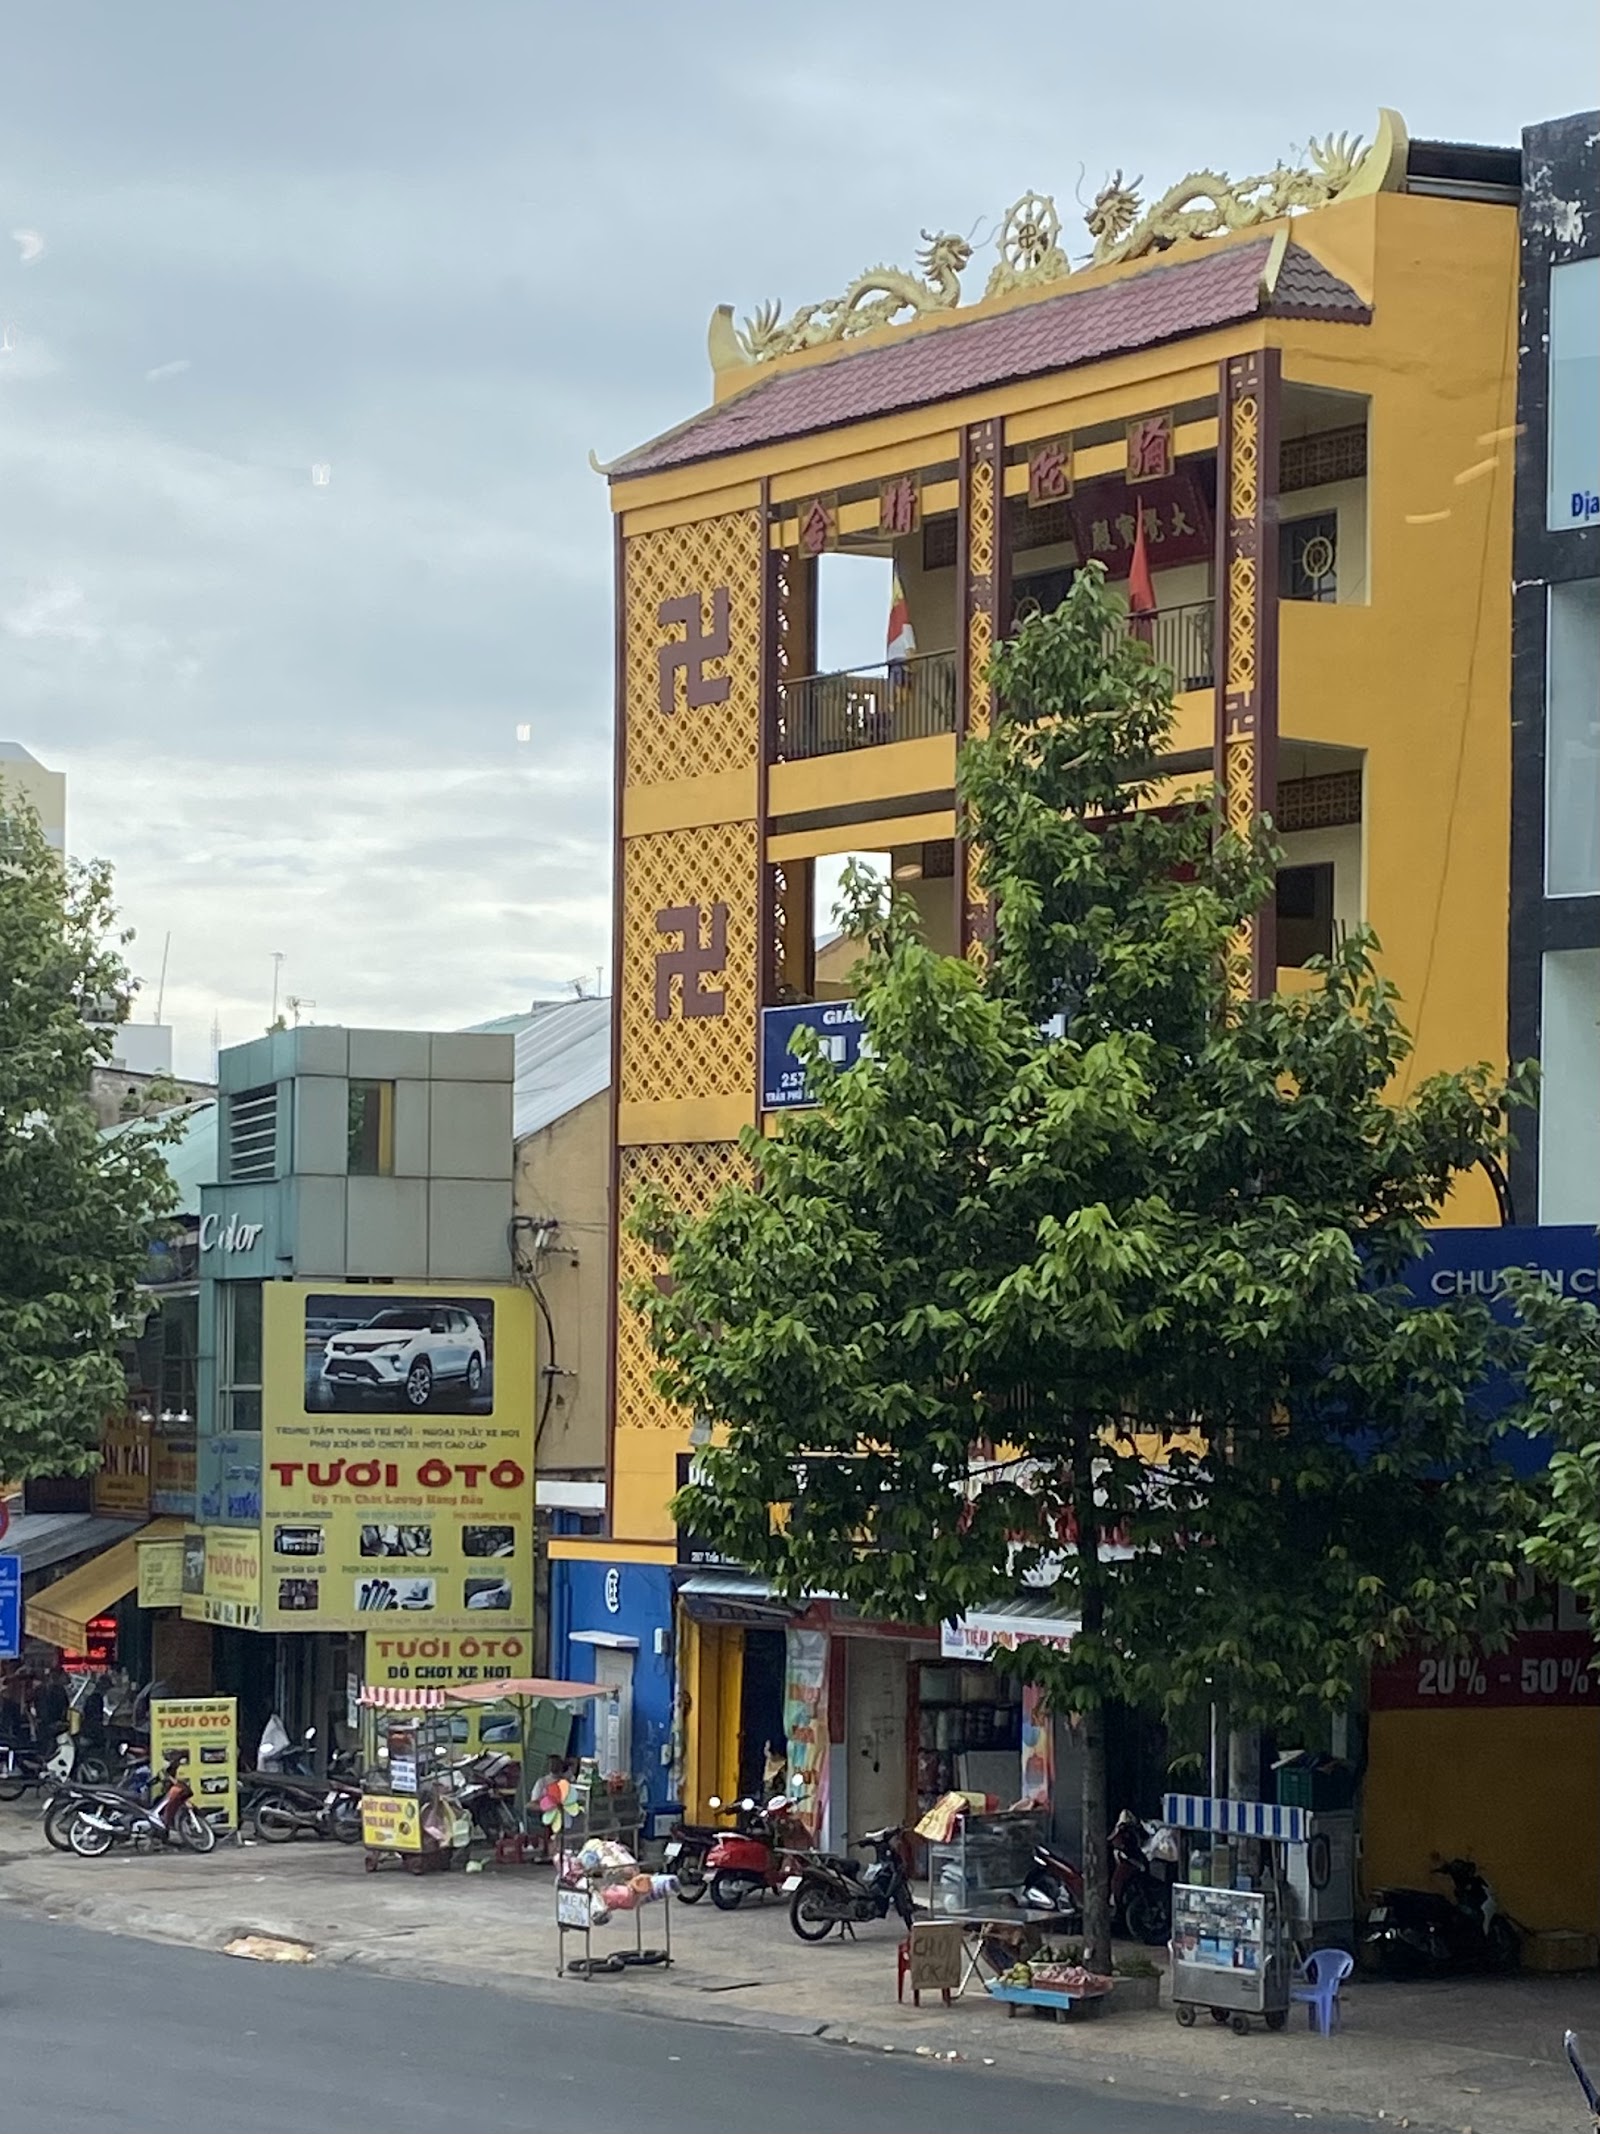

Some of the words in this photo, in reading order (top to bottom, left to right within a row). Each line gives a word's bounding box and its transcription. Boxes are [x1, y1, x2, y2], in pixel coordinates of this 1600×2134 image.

[200, 1212, 263, 1253] Color
[1569, 1268, 1600, 1294] C
[270, 1458, 398, 1488] TƯƠI
[417, 1458, 525, 1489] ÔTÔ
[375, 1637, 450, 1658] TƯƠI
[459, 1636, 524, 1658] ÔTÔ
[457, 1666, 478, 1678] XE
[1418, 1657, 1487, 1695] 20%
[1520, 1657, 1589, 1695] 50%
